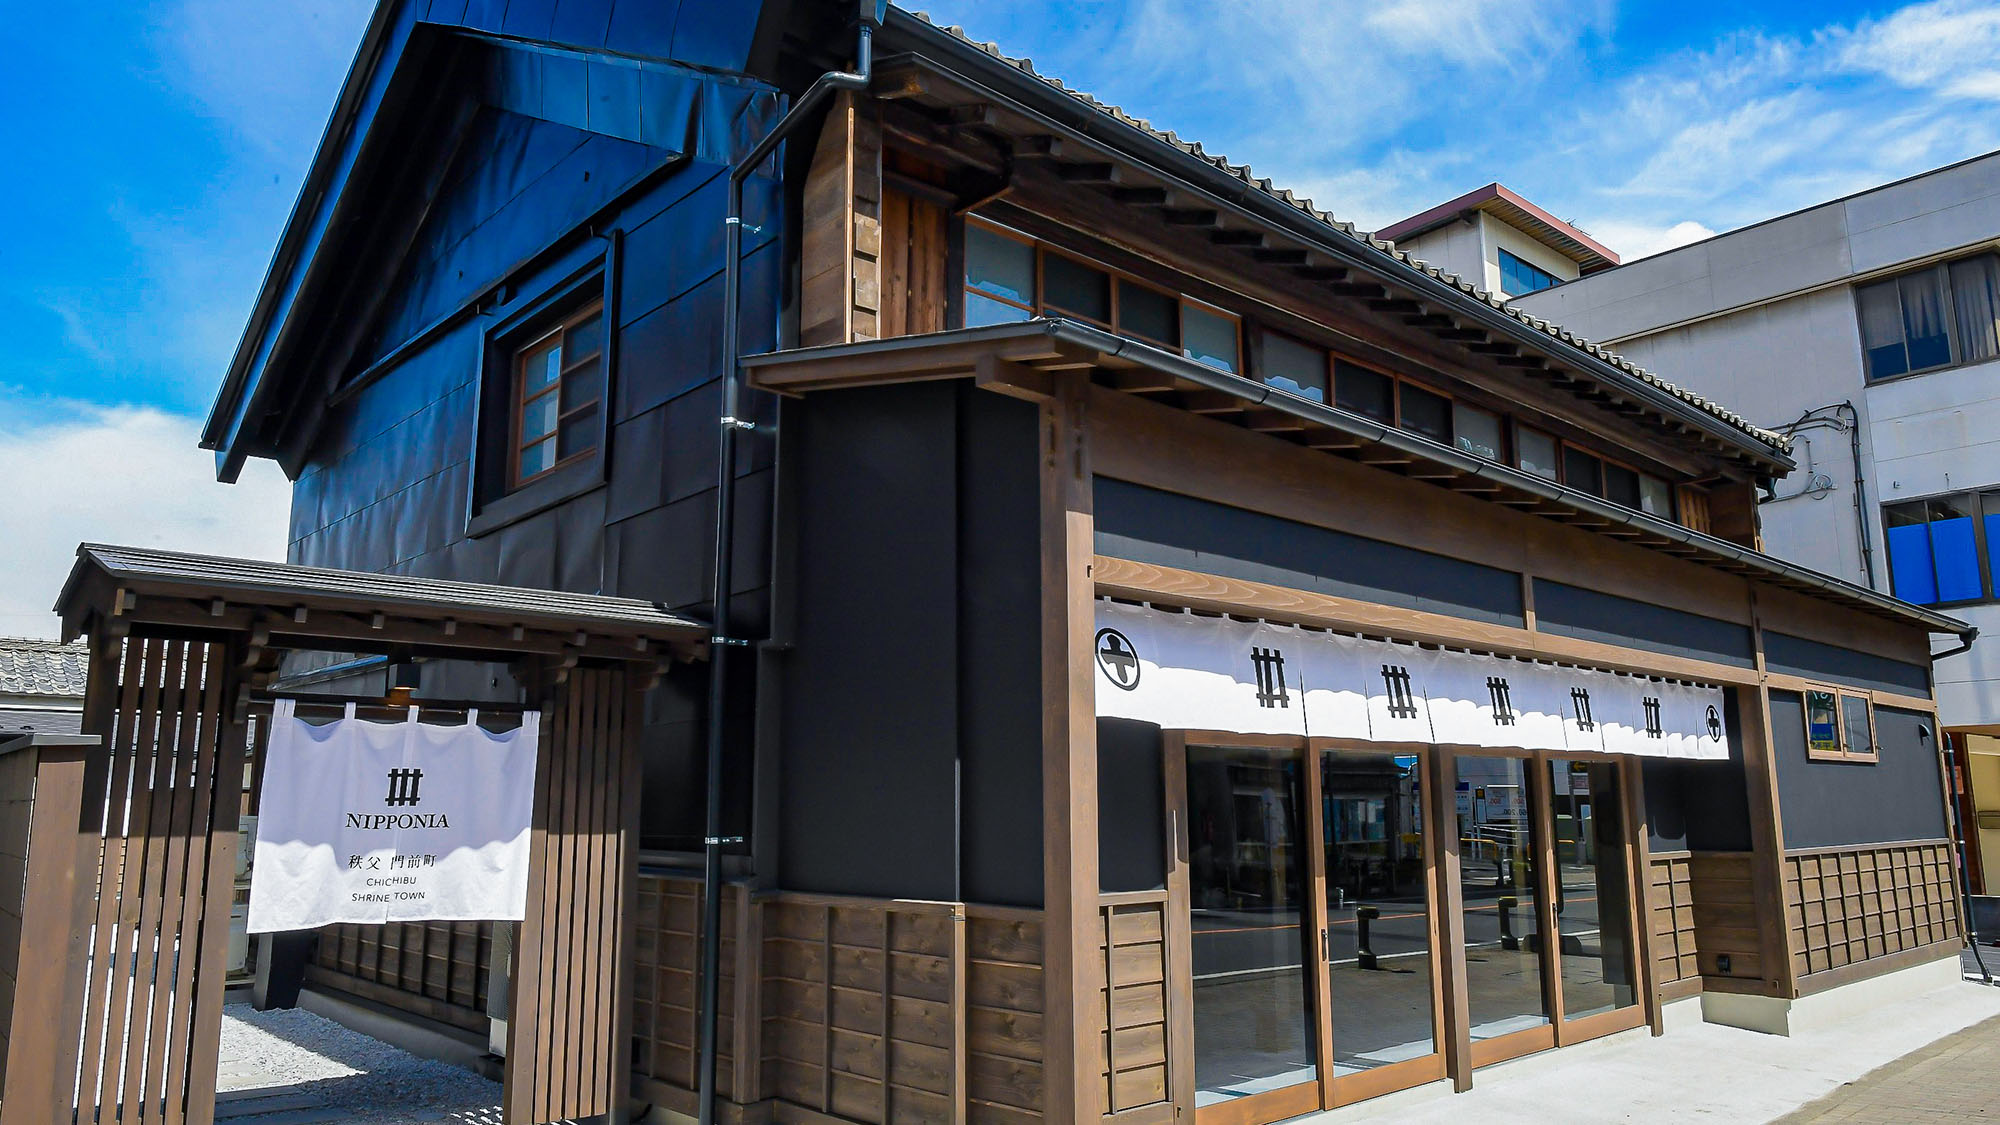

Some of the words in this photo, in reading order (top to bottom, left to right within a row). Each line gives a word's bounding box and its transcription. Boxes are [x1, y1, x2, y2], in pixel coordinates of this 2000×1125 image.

[345, 813, 450, 830] NIPPONIA
[348, 854, 382, 870] 秩父
[390, 854, 437, 870] 門前町
[366, 876, 417, 887] CHICHIBU
[351, 892, 390, 903] SHRINE
[394, 891, 426, 901] TOWN
